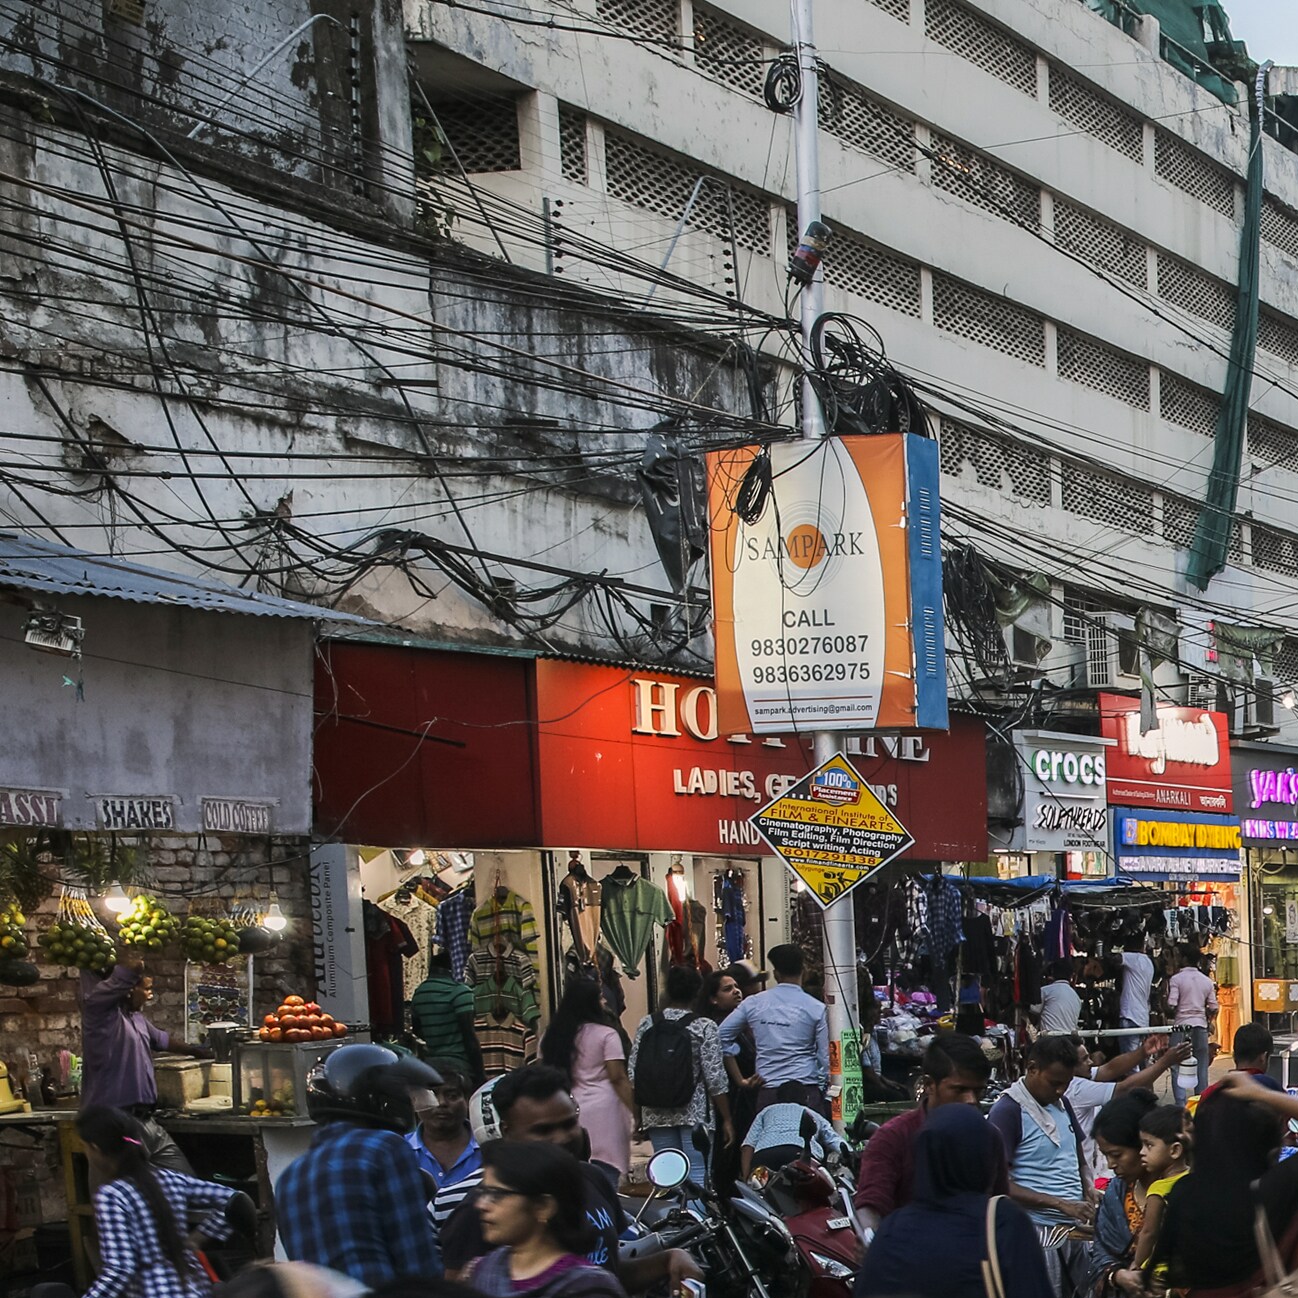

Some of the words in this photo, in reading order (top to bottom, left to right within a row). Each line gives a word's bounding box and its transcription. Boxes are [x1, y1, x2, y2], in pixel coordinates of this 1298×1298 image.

[748, 532, 864, 560] SAMPARK
[783, 609, 835, 628] CALL
[751, 635, 869, 656] 9830276087
[753, 662, 871, 683] 9836362975
[1034, 750, 1106, 786] crocs
[673, 767, 762, 803] LADIES,
[823, 771, 852, 789] 100%
[813, 786, 858, 798] Placement
[1156, 789, 1191, 805] ANARKALI
[102, 799, 172, 829] SHAKES
[204, 801, 231, 830] COLD
[232, 802, 269, 832] COFFEE
[770, 809, 802, 820] FILM
[808, 814, 819, 823] &
[825, 815, 894, 831] FINEARTS
[779, 802, 838, 815] International
[841, 810, 876, 820] Institute
[878, 814, 889, 822] of
[768, 828, 789, 837] Film
[831, 835, 850, 844] Film
[853, 839, 896, 850] Direction
[842, 828, 904, 844] Photography
[1138, 821, 1197, 847] BOMBAY
[1245, 819, 1276, 839] KIDS
[781, 838, 811, 850] Script
[850, 846, 881, 858] Acting
[1063, 839, 1082, 848] LONDON
[783, 848, 877, 865] 8017291338
[322, 861, 331, 889] Panel
[324, 892, 335, 942] Composite
[327, 944, 337, 998] Aluminium
